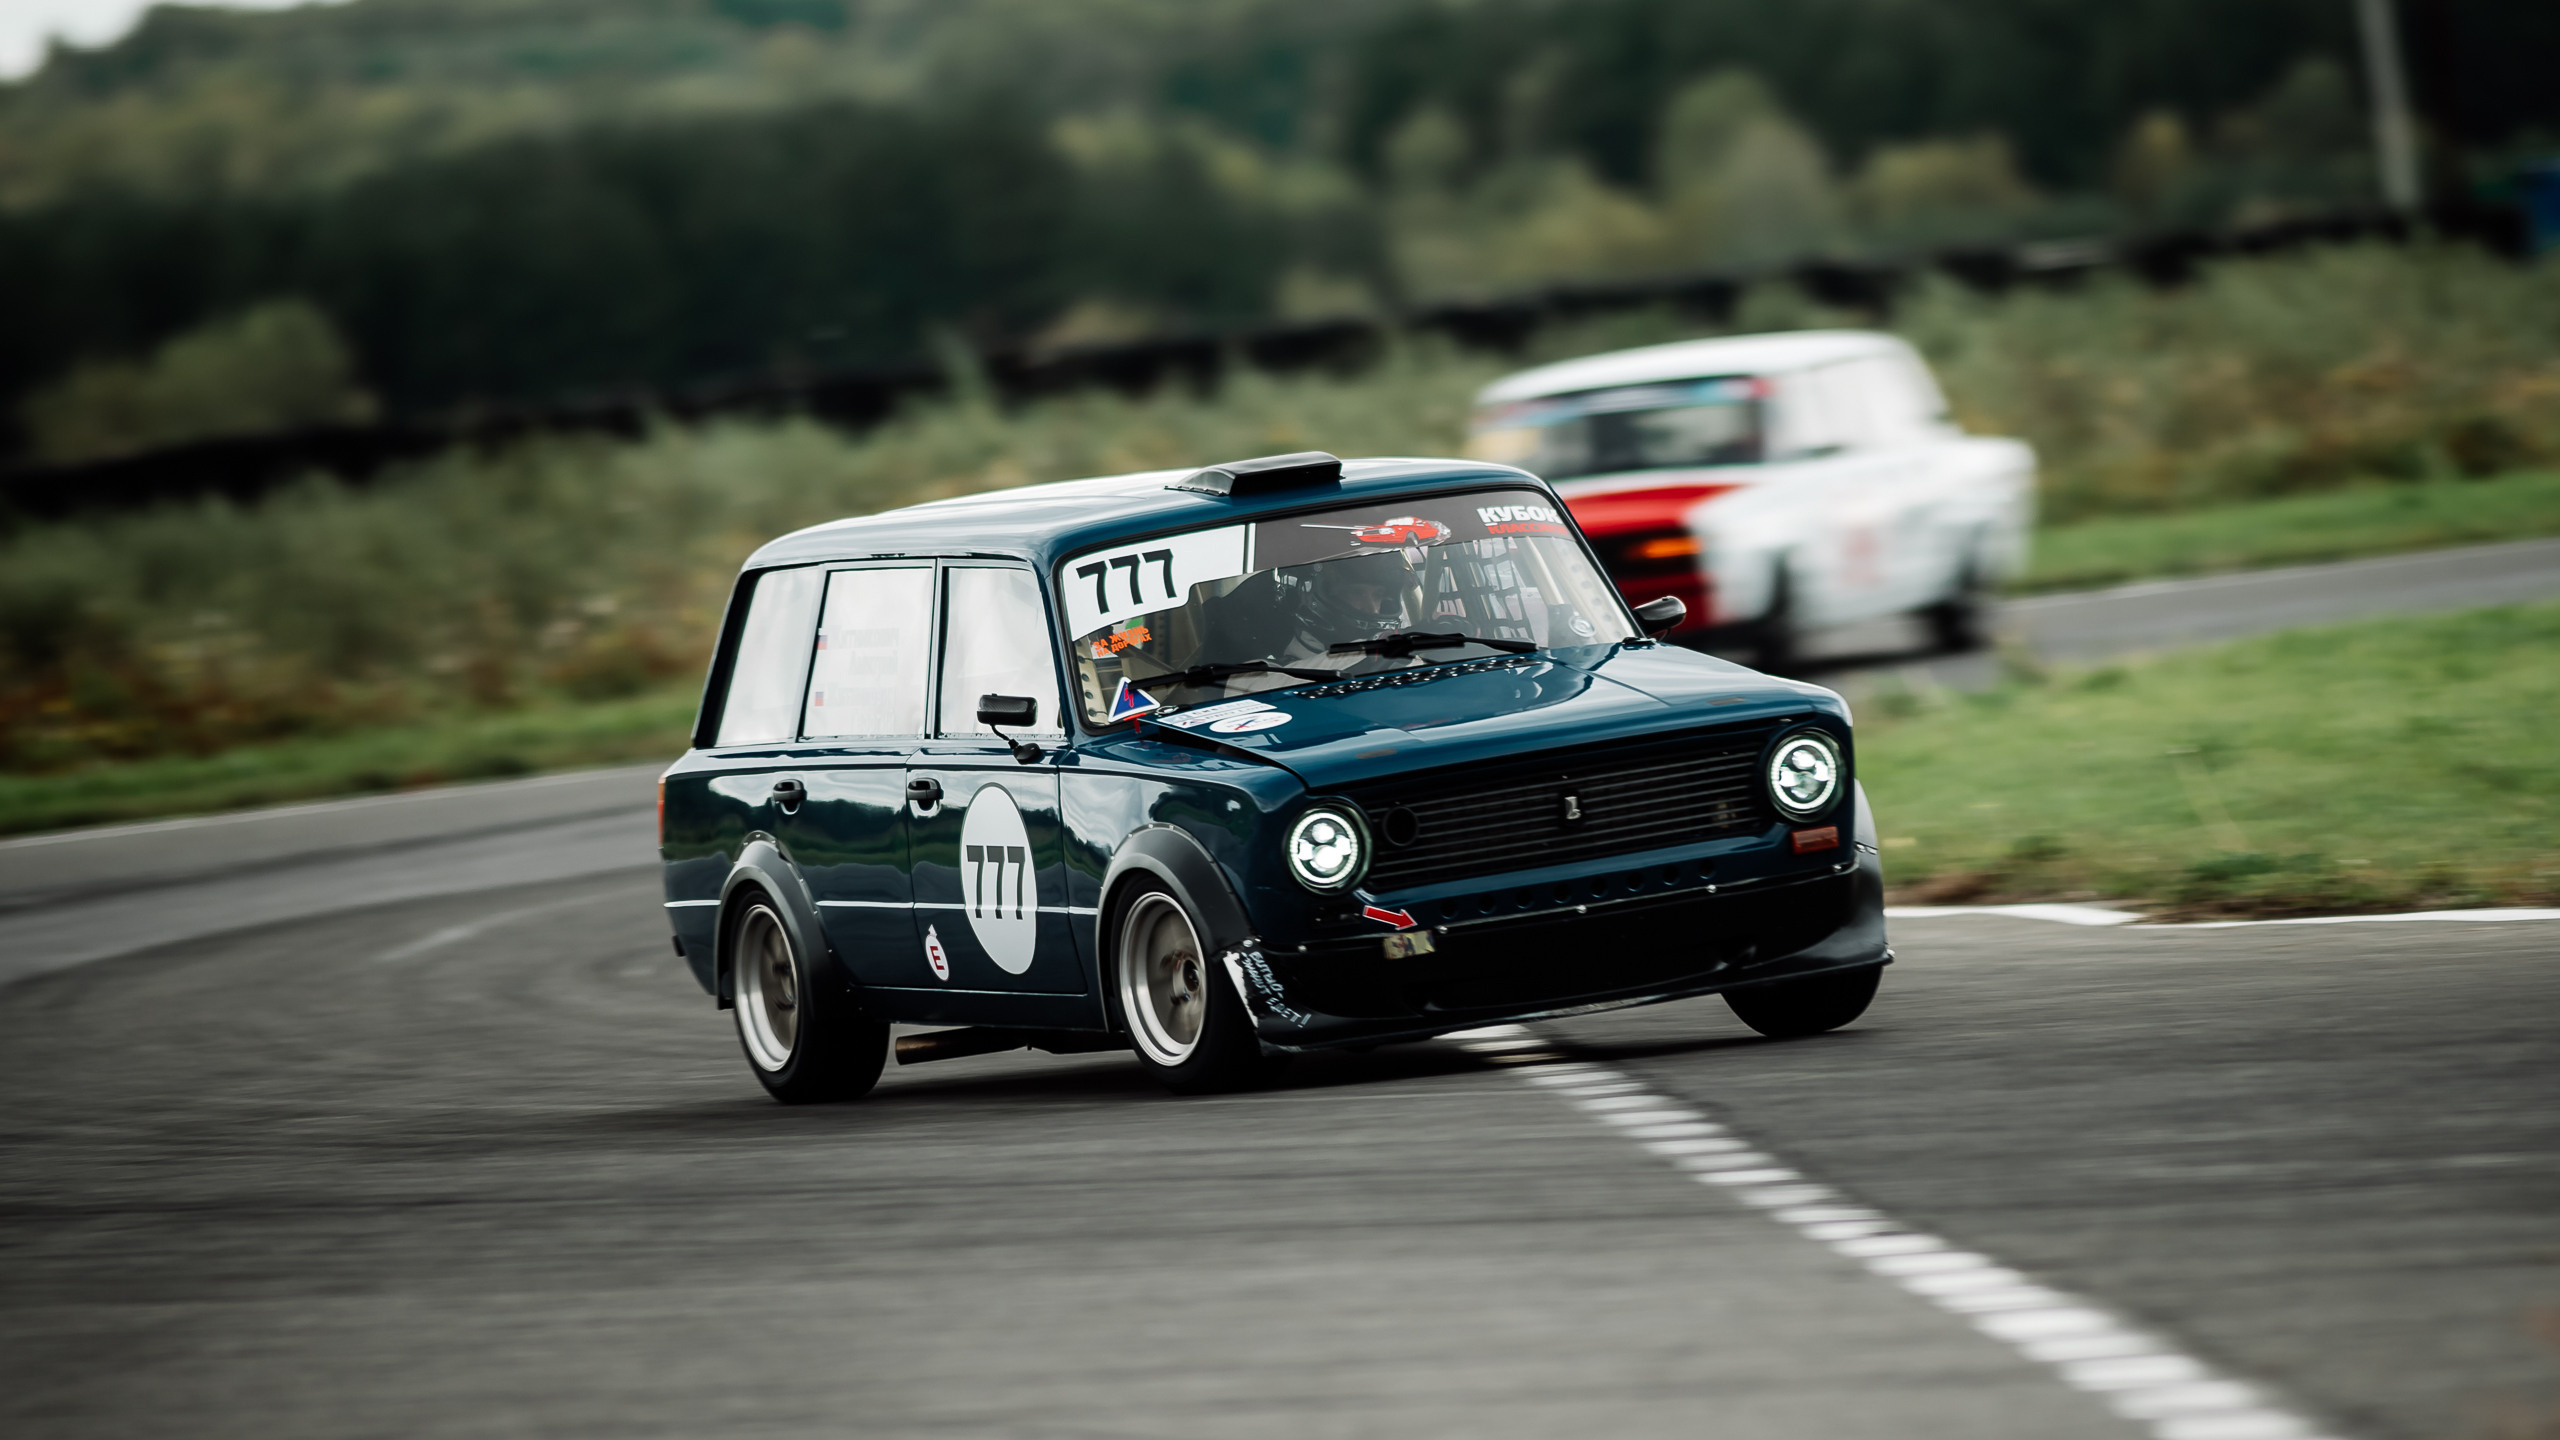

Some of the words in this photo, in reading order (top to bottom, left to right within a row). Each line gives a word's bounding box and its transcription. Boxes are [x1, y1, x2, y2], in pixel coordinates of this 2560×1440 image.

[1476, 505, 1563, 524] КУБОК
[1076, 549, 1177, 614] 777
[1093, 638, 1108, 650] ЗА
[1109, 626, 1149, 643] ЖИЗНЬ
[1096, 647, 1110, 657] НА
[1111, 633, 1152, 653] ДОРОГАХ
[966, 845, 1025, 920] 777
[930, 946, 945, 970] E
